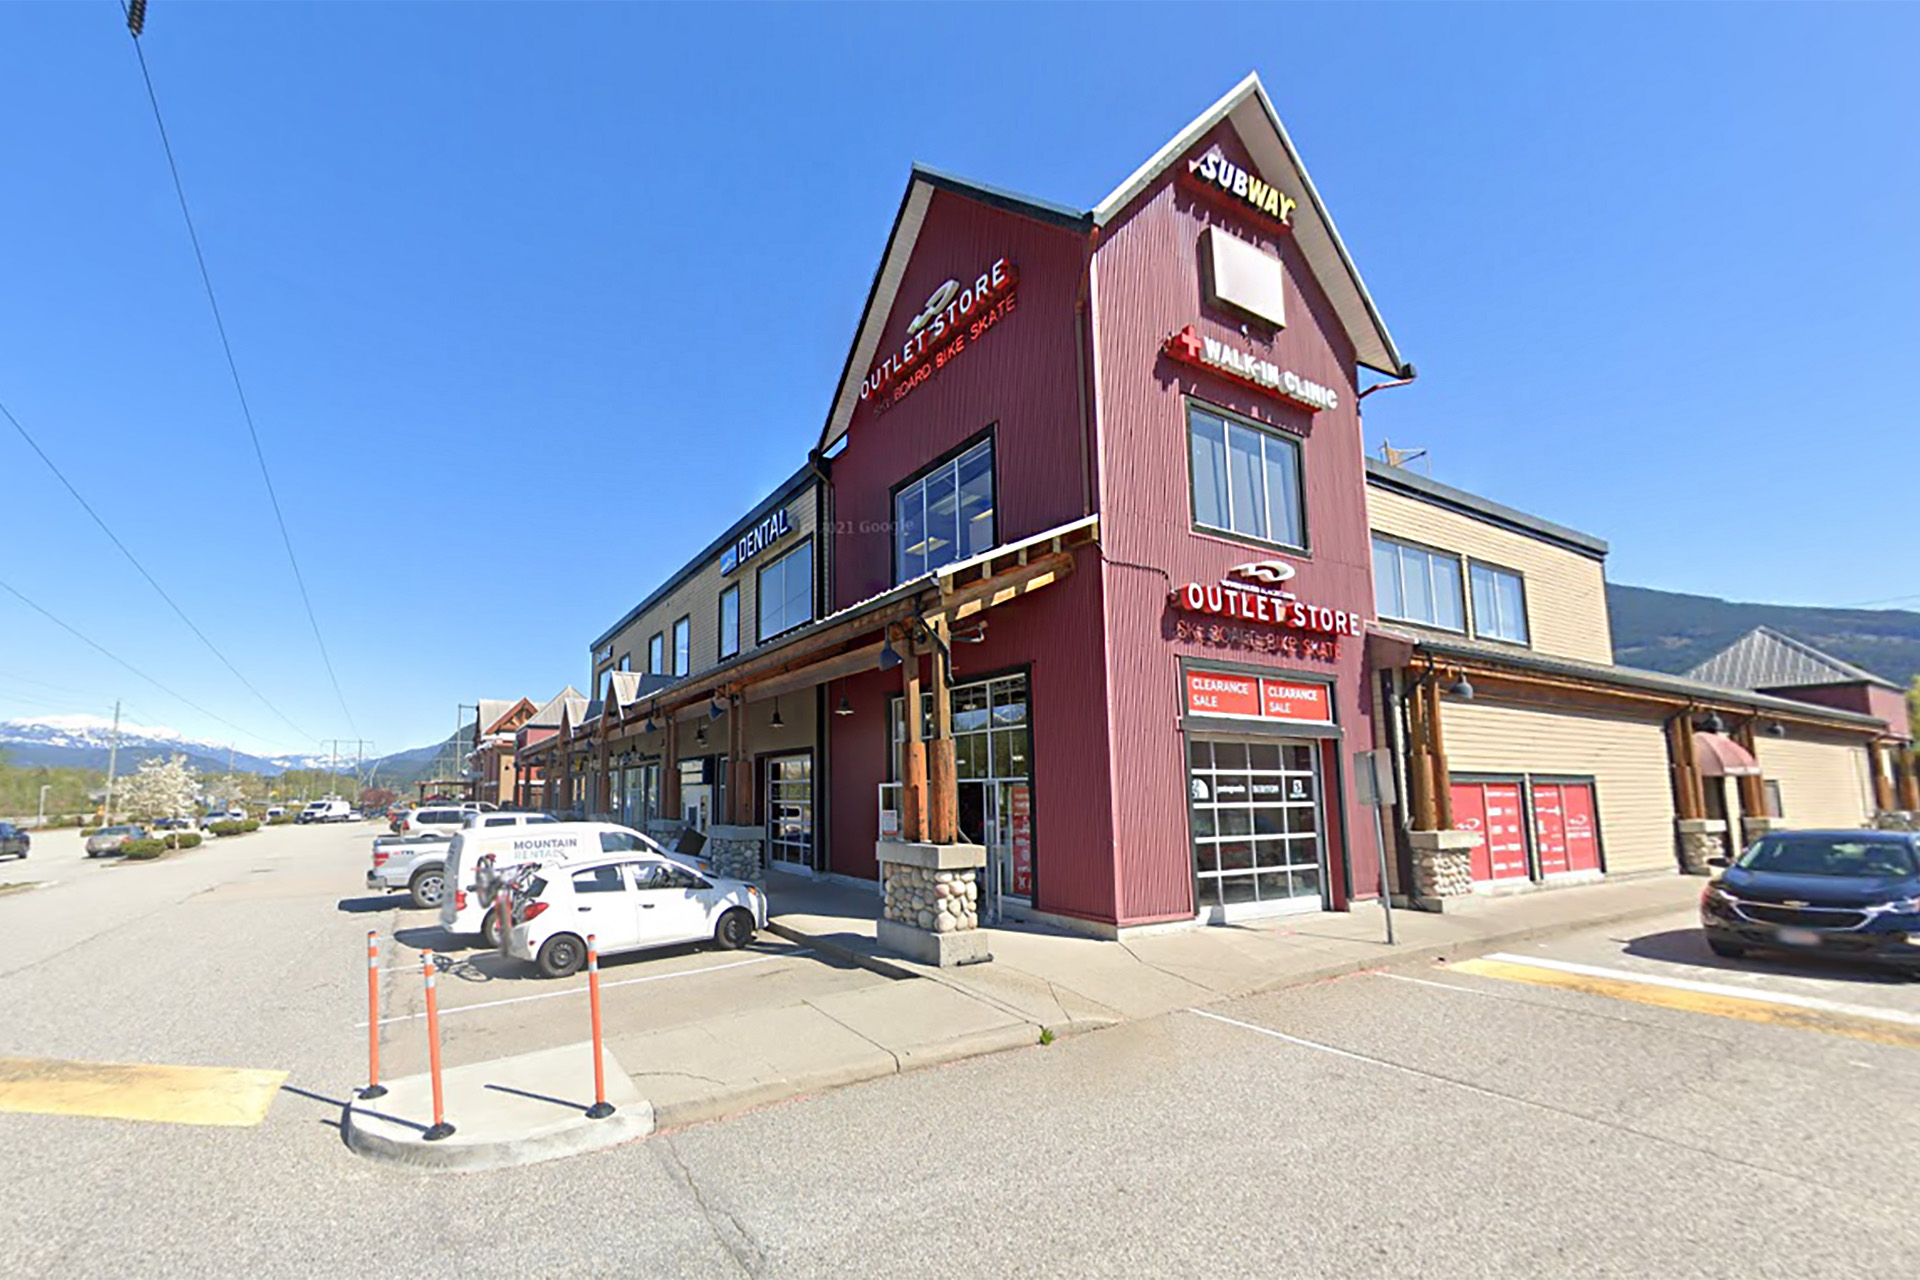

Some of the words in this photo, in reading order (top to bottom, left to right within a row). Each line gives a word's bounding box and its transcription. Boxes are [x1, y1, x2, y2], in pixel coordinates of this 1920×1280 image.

[1188, 151, 1296, 225] SUBWAY
[860, 329, 925, 400] OUTLET
[933, 258, 1006, 337] STORE
[893, 363, 932, 401] BOARD
[935, 334, 965, 368] BIKE
[970, 291, 1016, 341] SKATE
[1203, 335, 1279, 386] WALK-IN
[1283, 370, 1338, 410] CLINIC
[738, 509, 789, 563] DENTAL
[1187, 582, 1284, 623] OUTLET
[1293, 602, 1361, 637] STORE
[1191, 677, 1249, 695] CLEARANCE
[1192, 695, 1218, 708] SALE
[1268, 685, 1318, 702] CLEARANCE
[1269, 701, 1291, 714] SALE
[513, 837, 577, 850] MOUNTAIN
